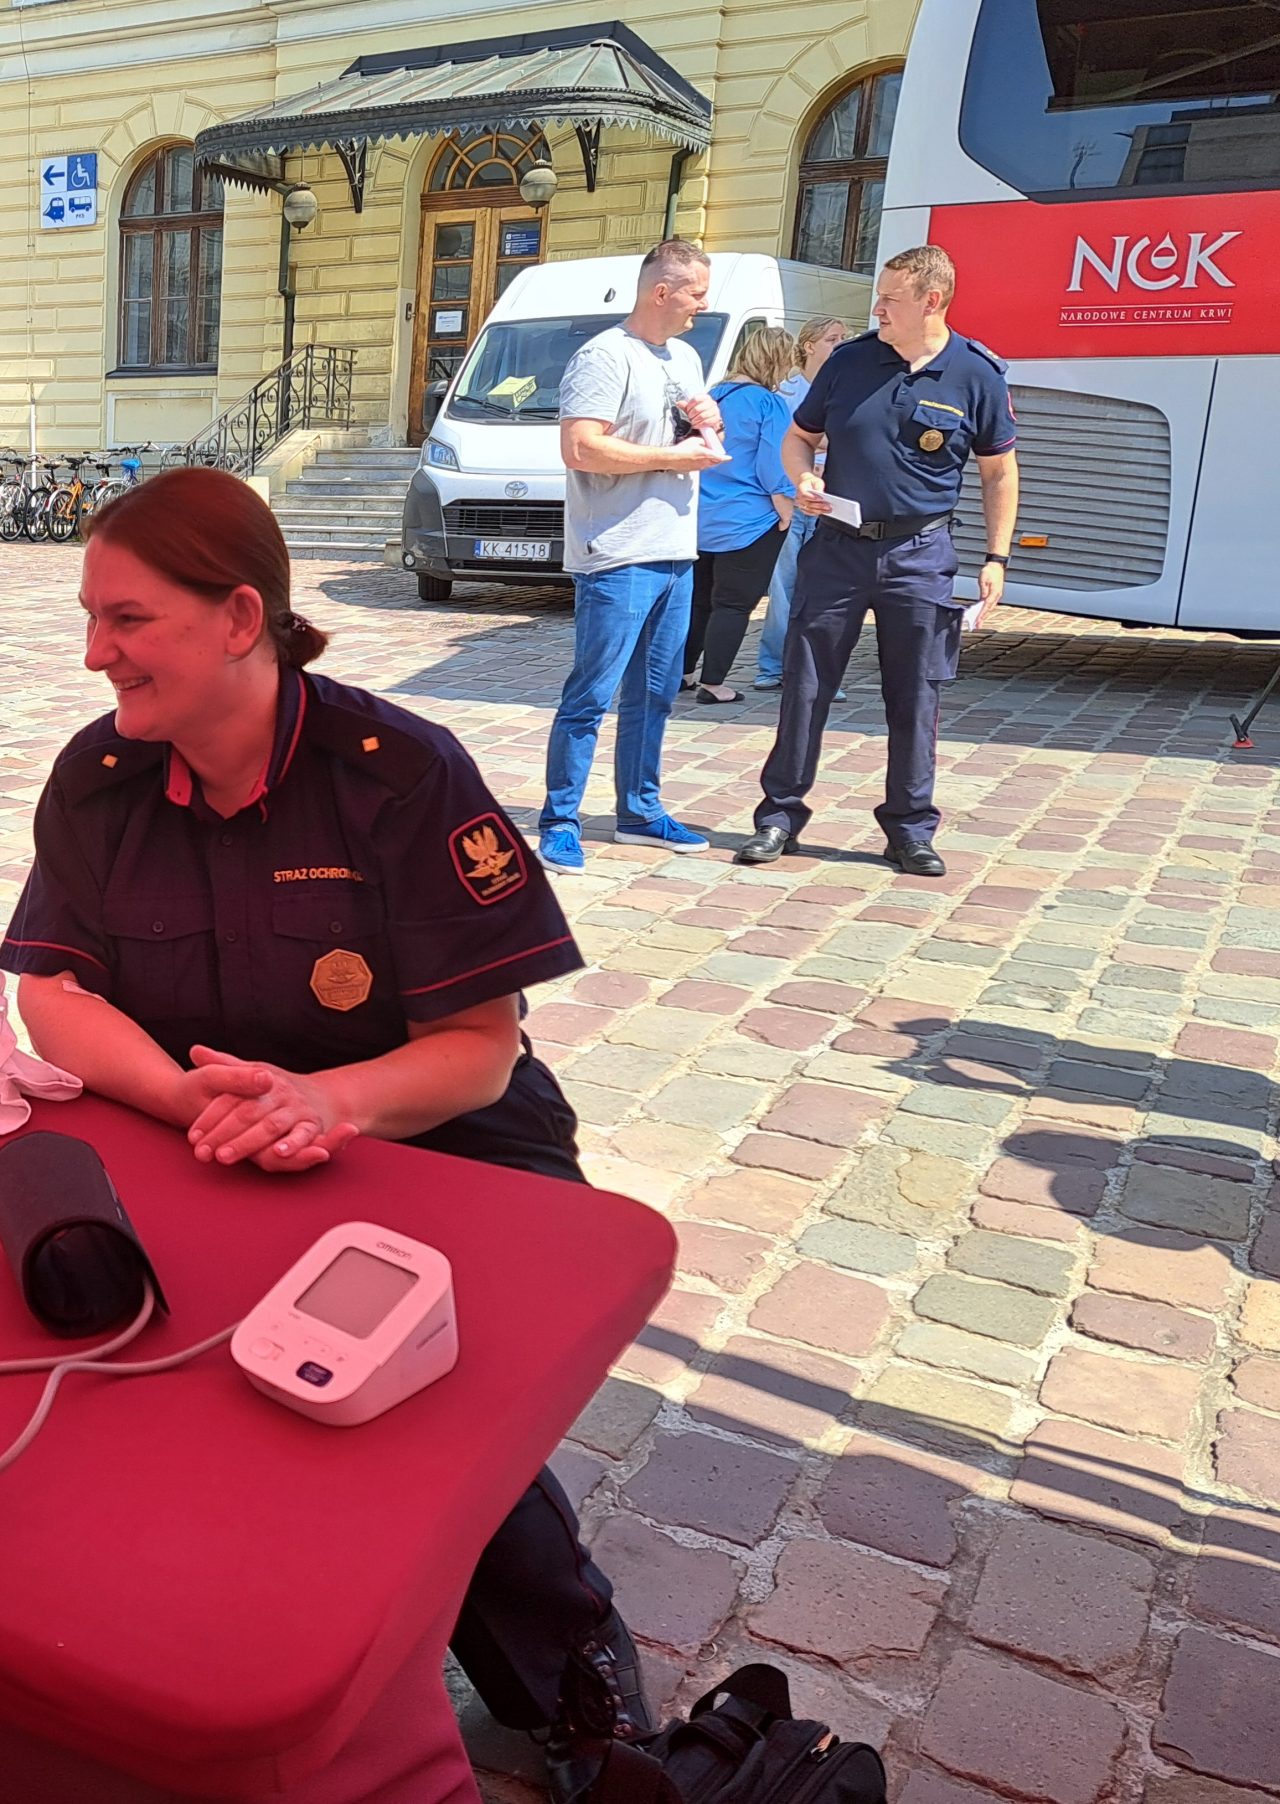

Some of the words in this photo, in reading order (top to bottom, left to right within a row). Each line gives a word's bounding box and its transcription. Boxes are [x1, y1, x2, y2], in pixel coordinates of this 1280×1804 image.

[1065, 230, 1244, 293] NCK
[1059, 310, 1126, 322] NARODOWE
[1133, 309, 1192, 320] CENTRUM
[1200, 308, 1233, 319] KRWI
[483, 542, 500, 556] KK
[504, 543, 546, 558] 41518
